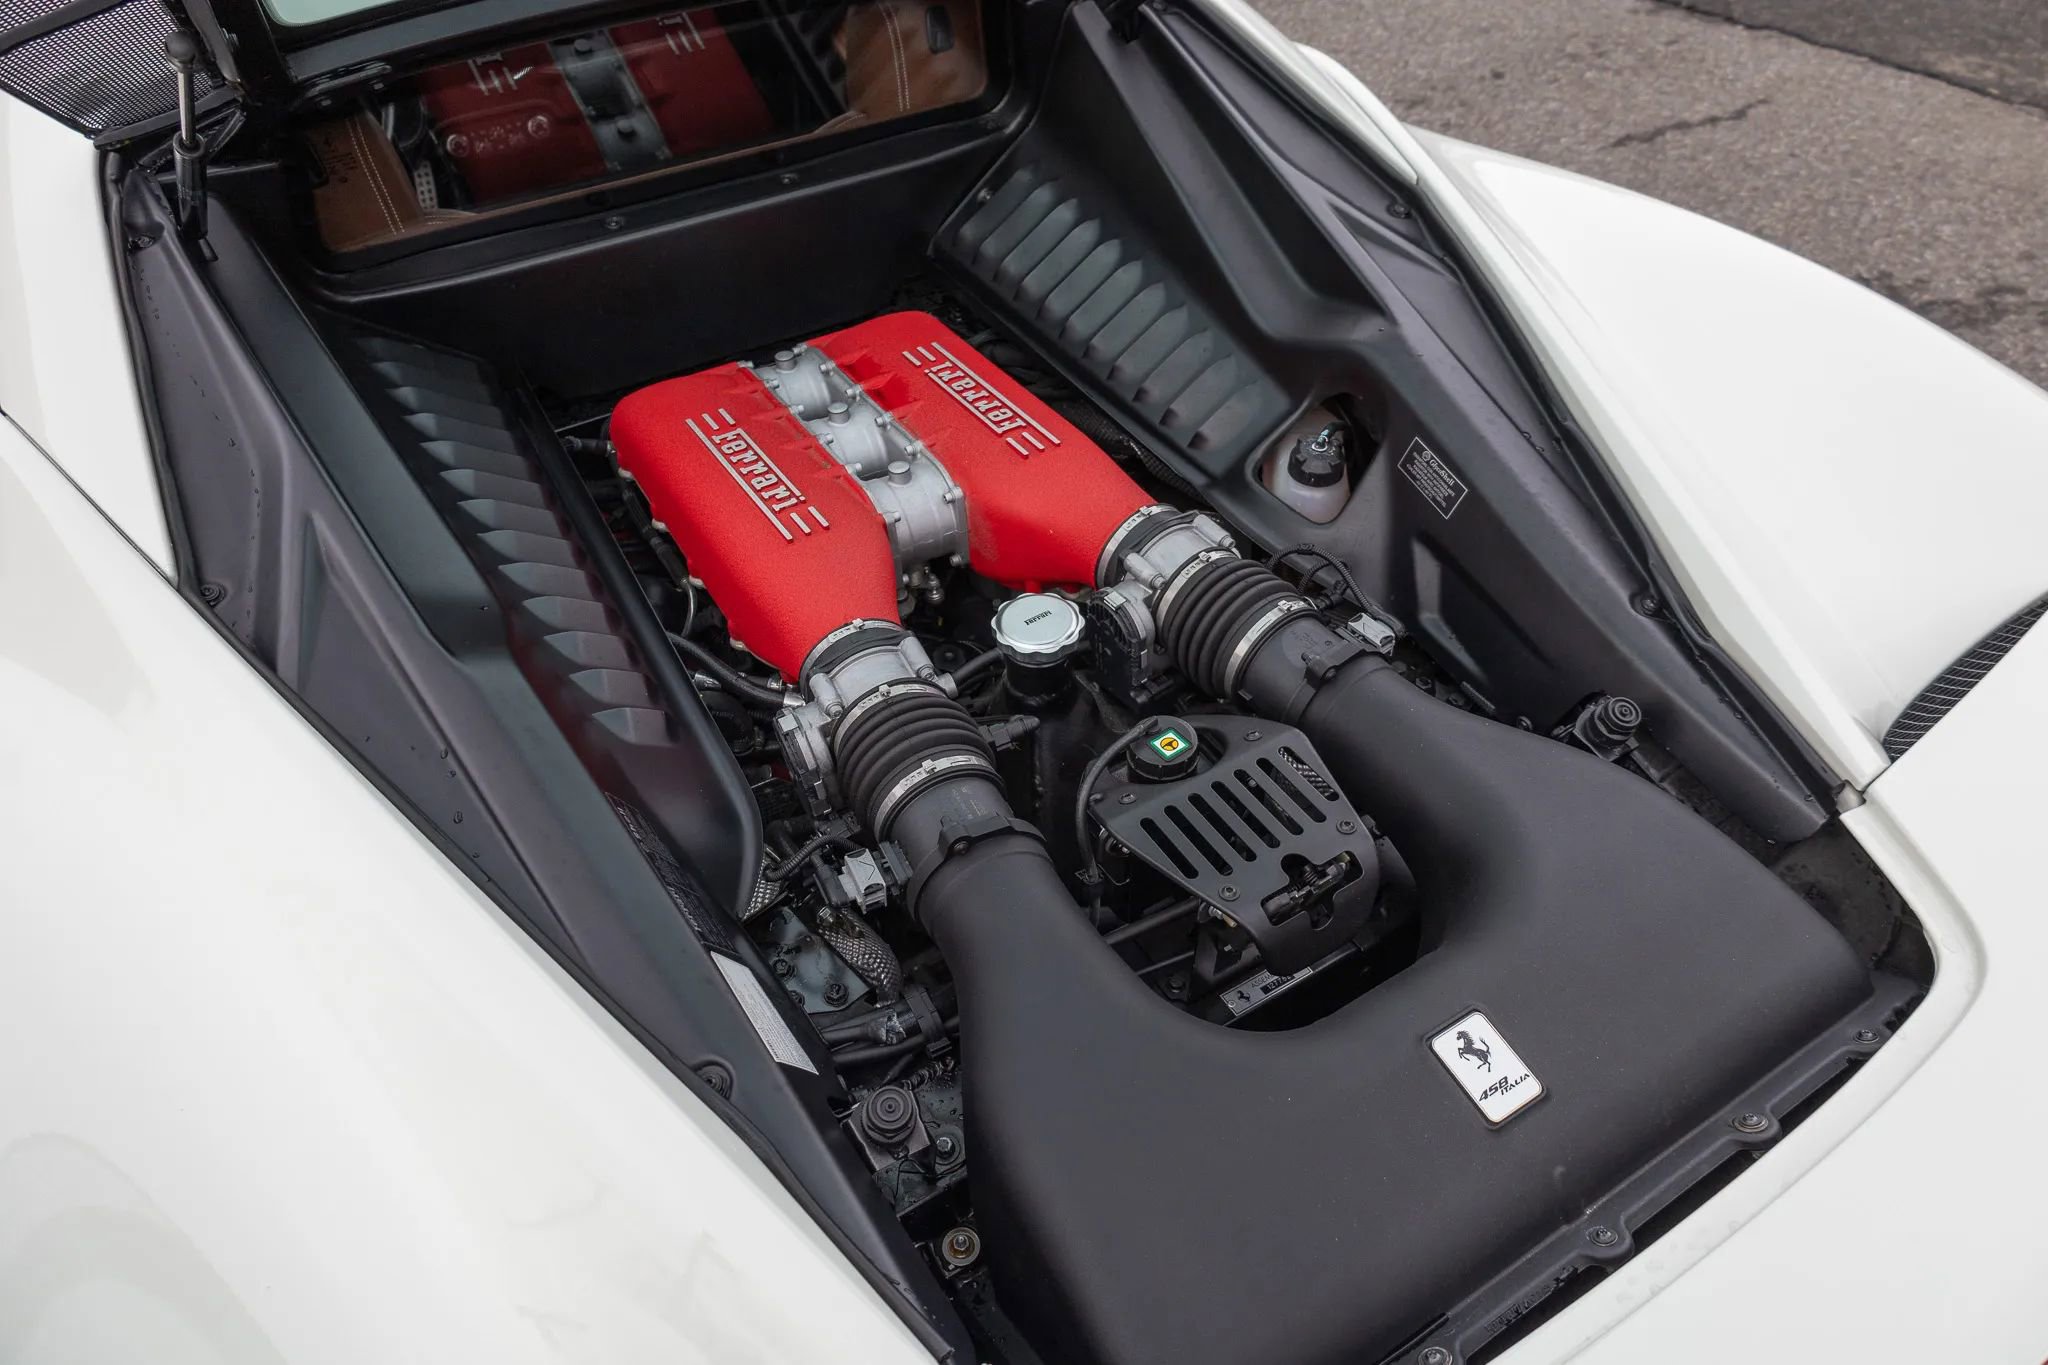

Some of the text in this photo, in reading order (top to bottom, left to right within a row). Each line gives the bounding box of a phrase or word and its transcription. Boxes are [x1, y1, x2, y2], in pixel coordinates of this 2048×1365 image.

[924, 361, 1027, 435] Ferrari
[711, 428, 806, 512] Ferrari
[1023, 609, 1053, 627] Ferrari
[1479, 1075, 1509, 1102] 458
[1500, 1073, 1530, 1096] ITALIA
